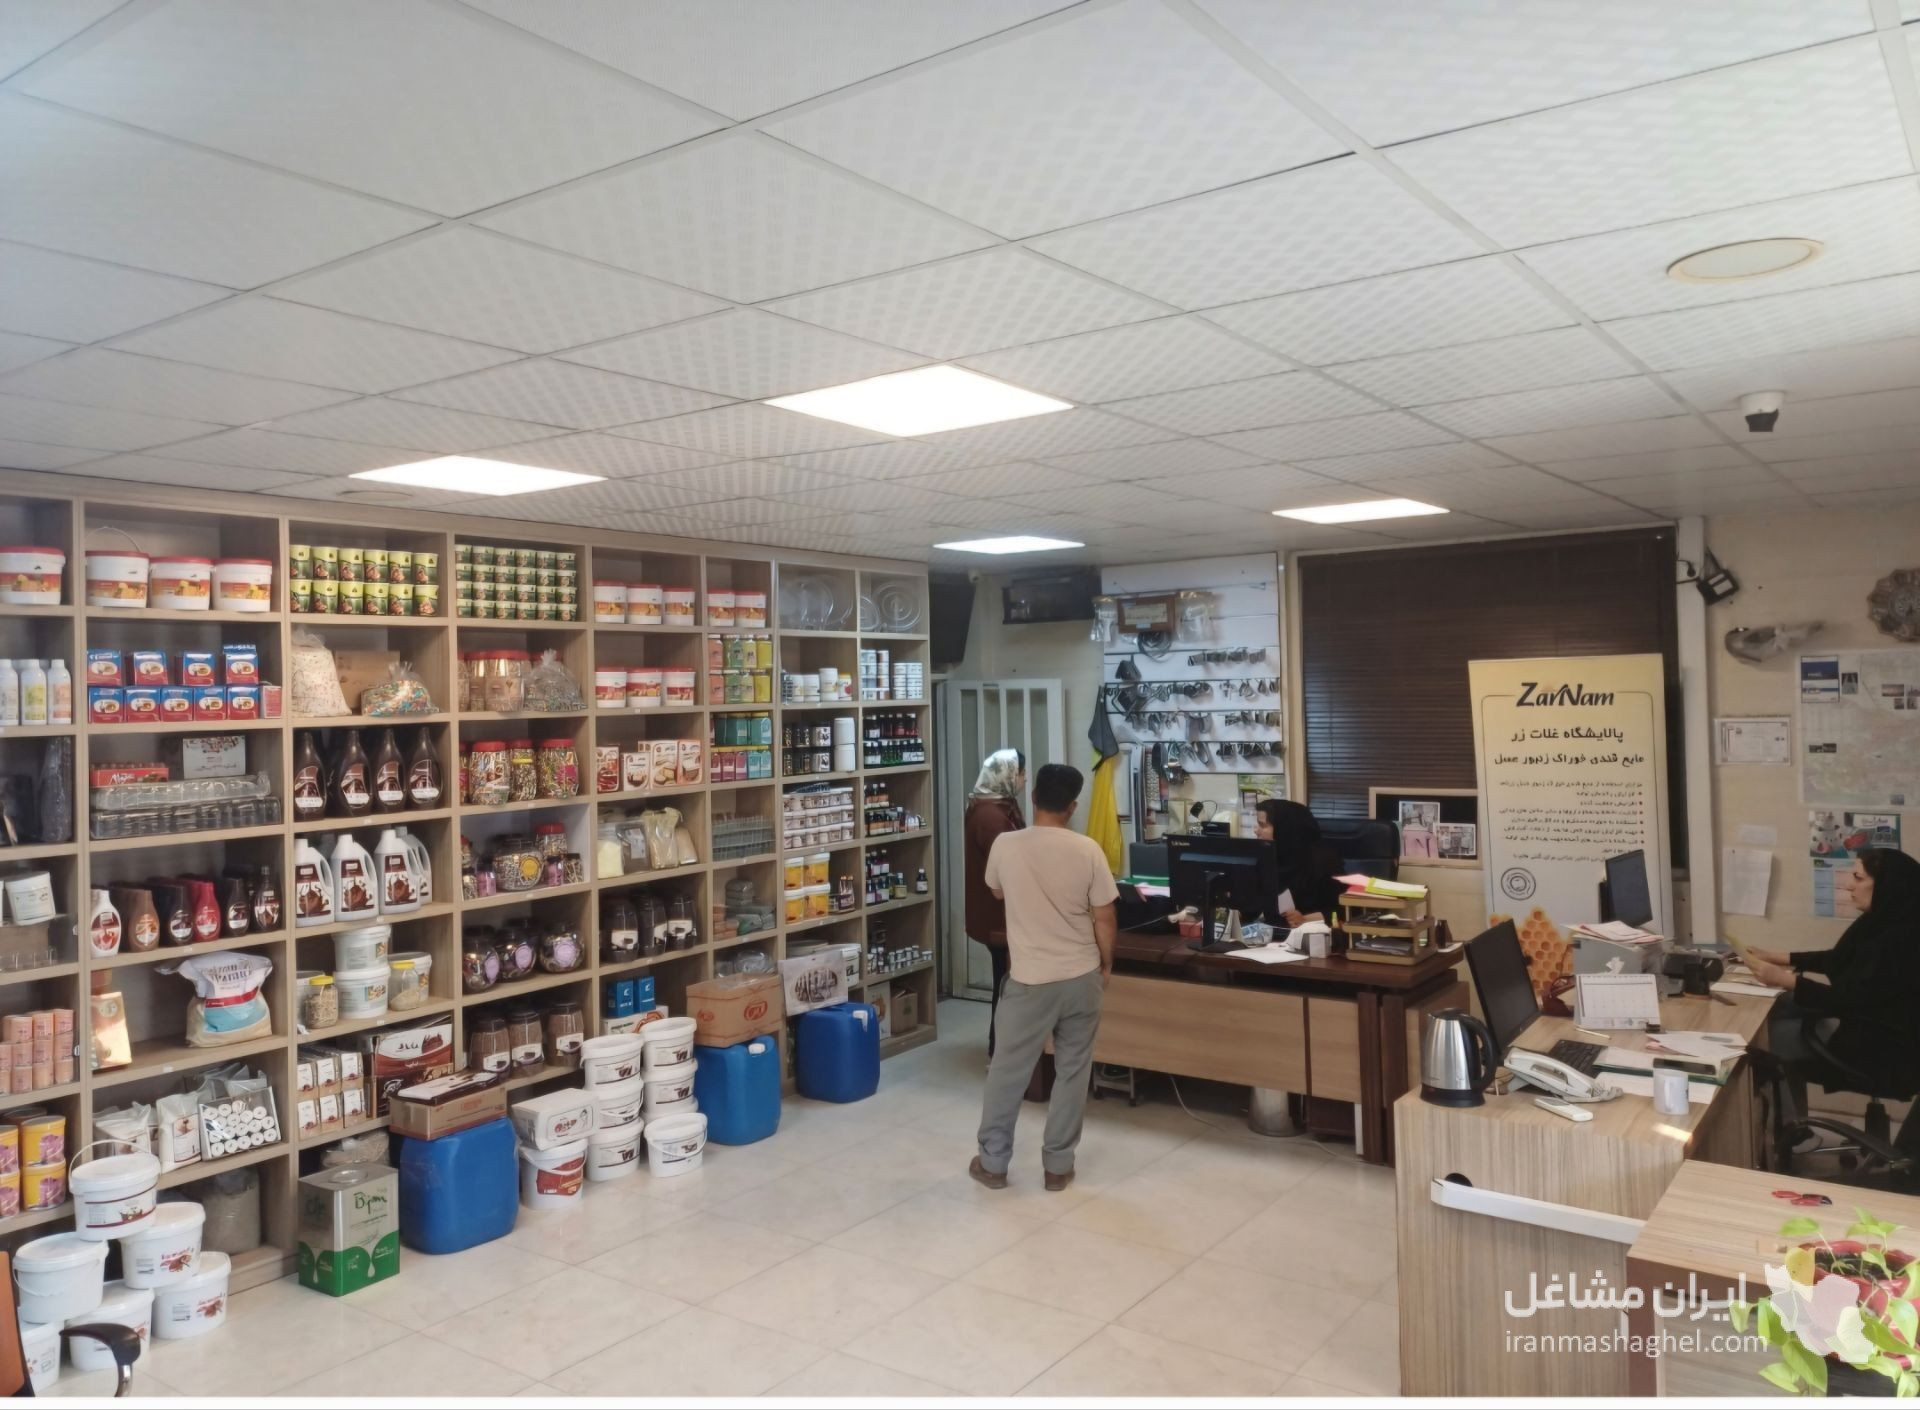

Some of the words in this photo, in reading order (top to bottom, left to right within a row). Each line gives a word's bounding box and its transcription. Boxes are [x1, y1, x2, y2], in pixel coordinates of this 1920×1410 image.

[1511, 728, 1526, 742] زر
[1530, 727, 1560, 739] غلات
[1563, 726, 1624, 743] پالایشگاه
[1552, 753, 1586, 765] خوراک
